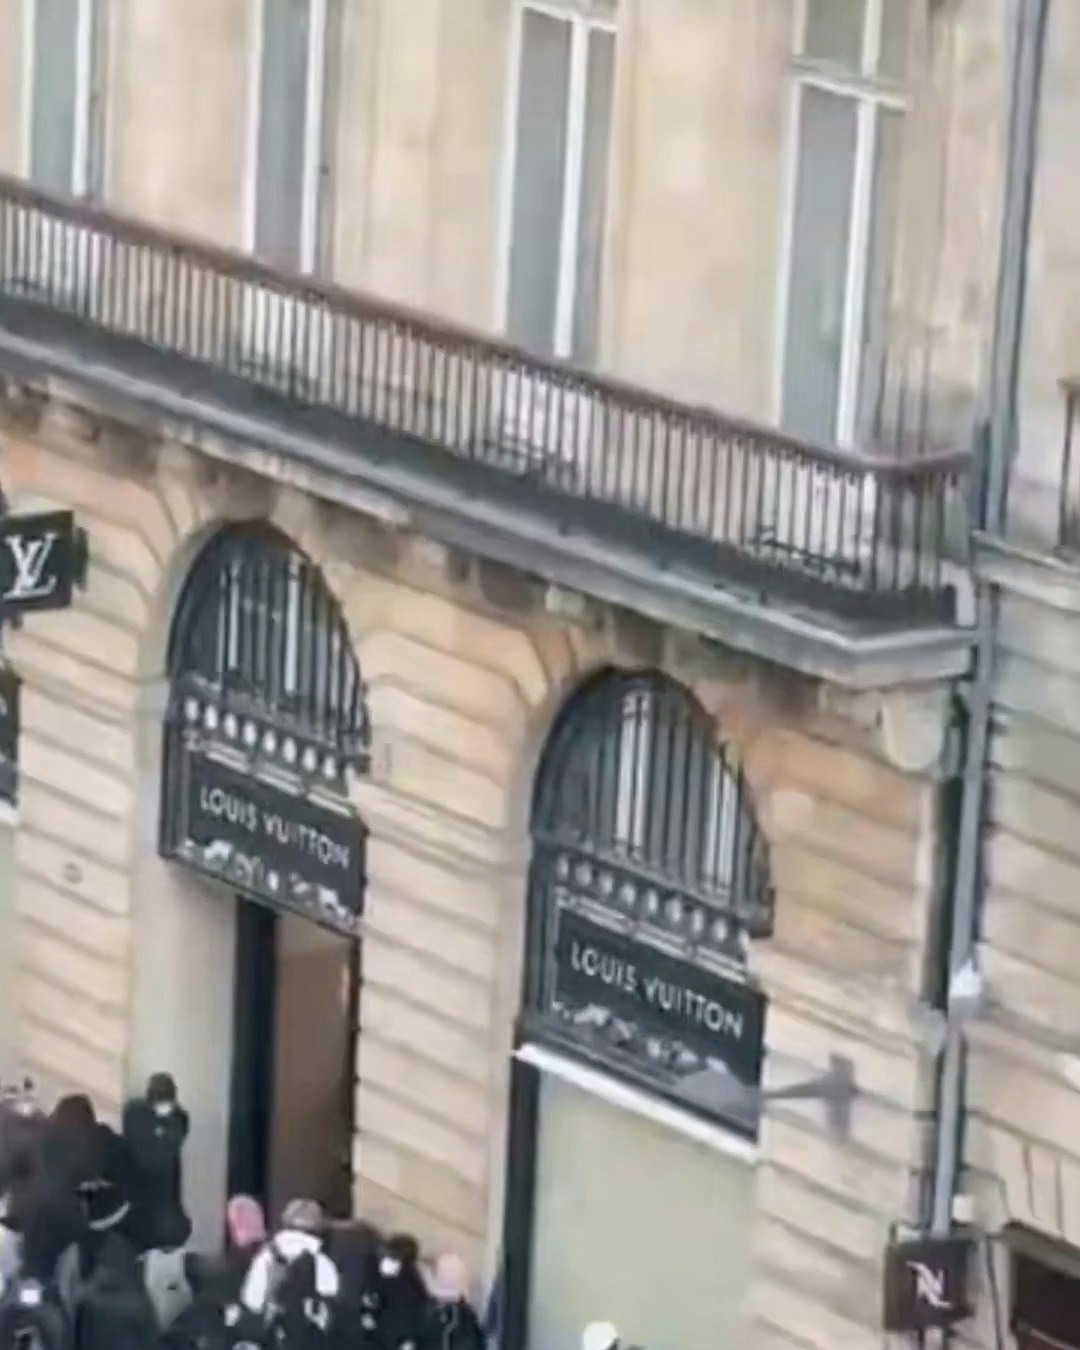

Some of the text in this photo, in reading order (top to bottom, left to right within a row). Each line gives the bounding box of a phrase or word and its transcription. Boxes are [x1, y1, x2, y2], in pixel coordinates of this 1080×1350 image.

[200, 784, 350, 869] LOUIS VUITTON
[571, 940, 744, 1039] LOUIS VUITTON
